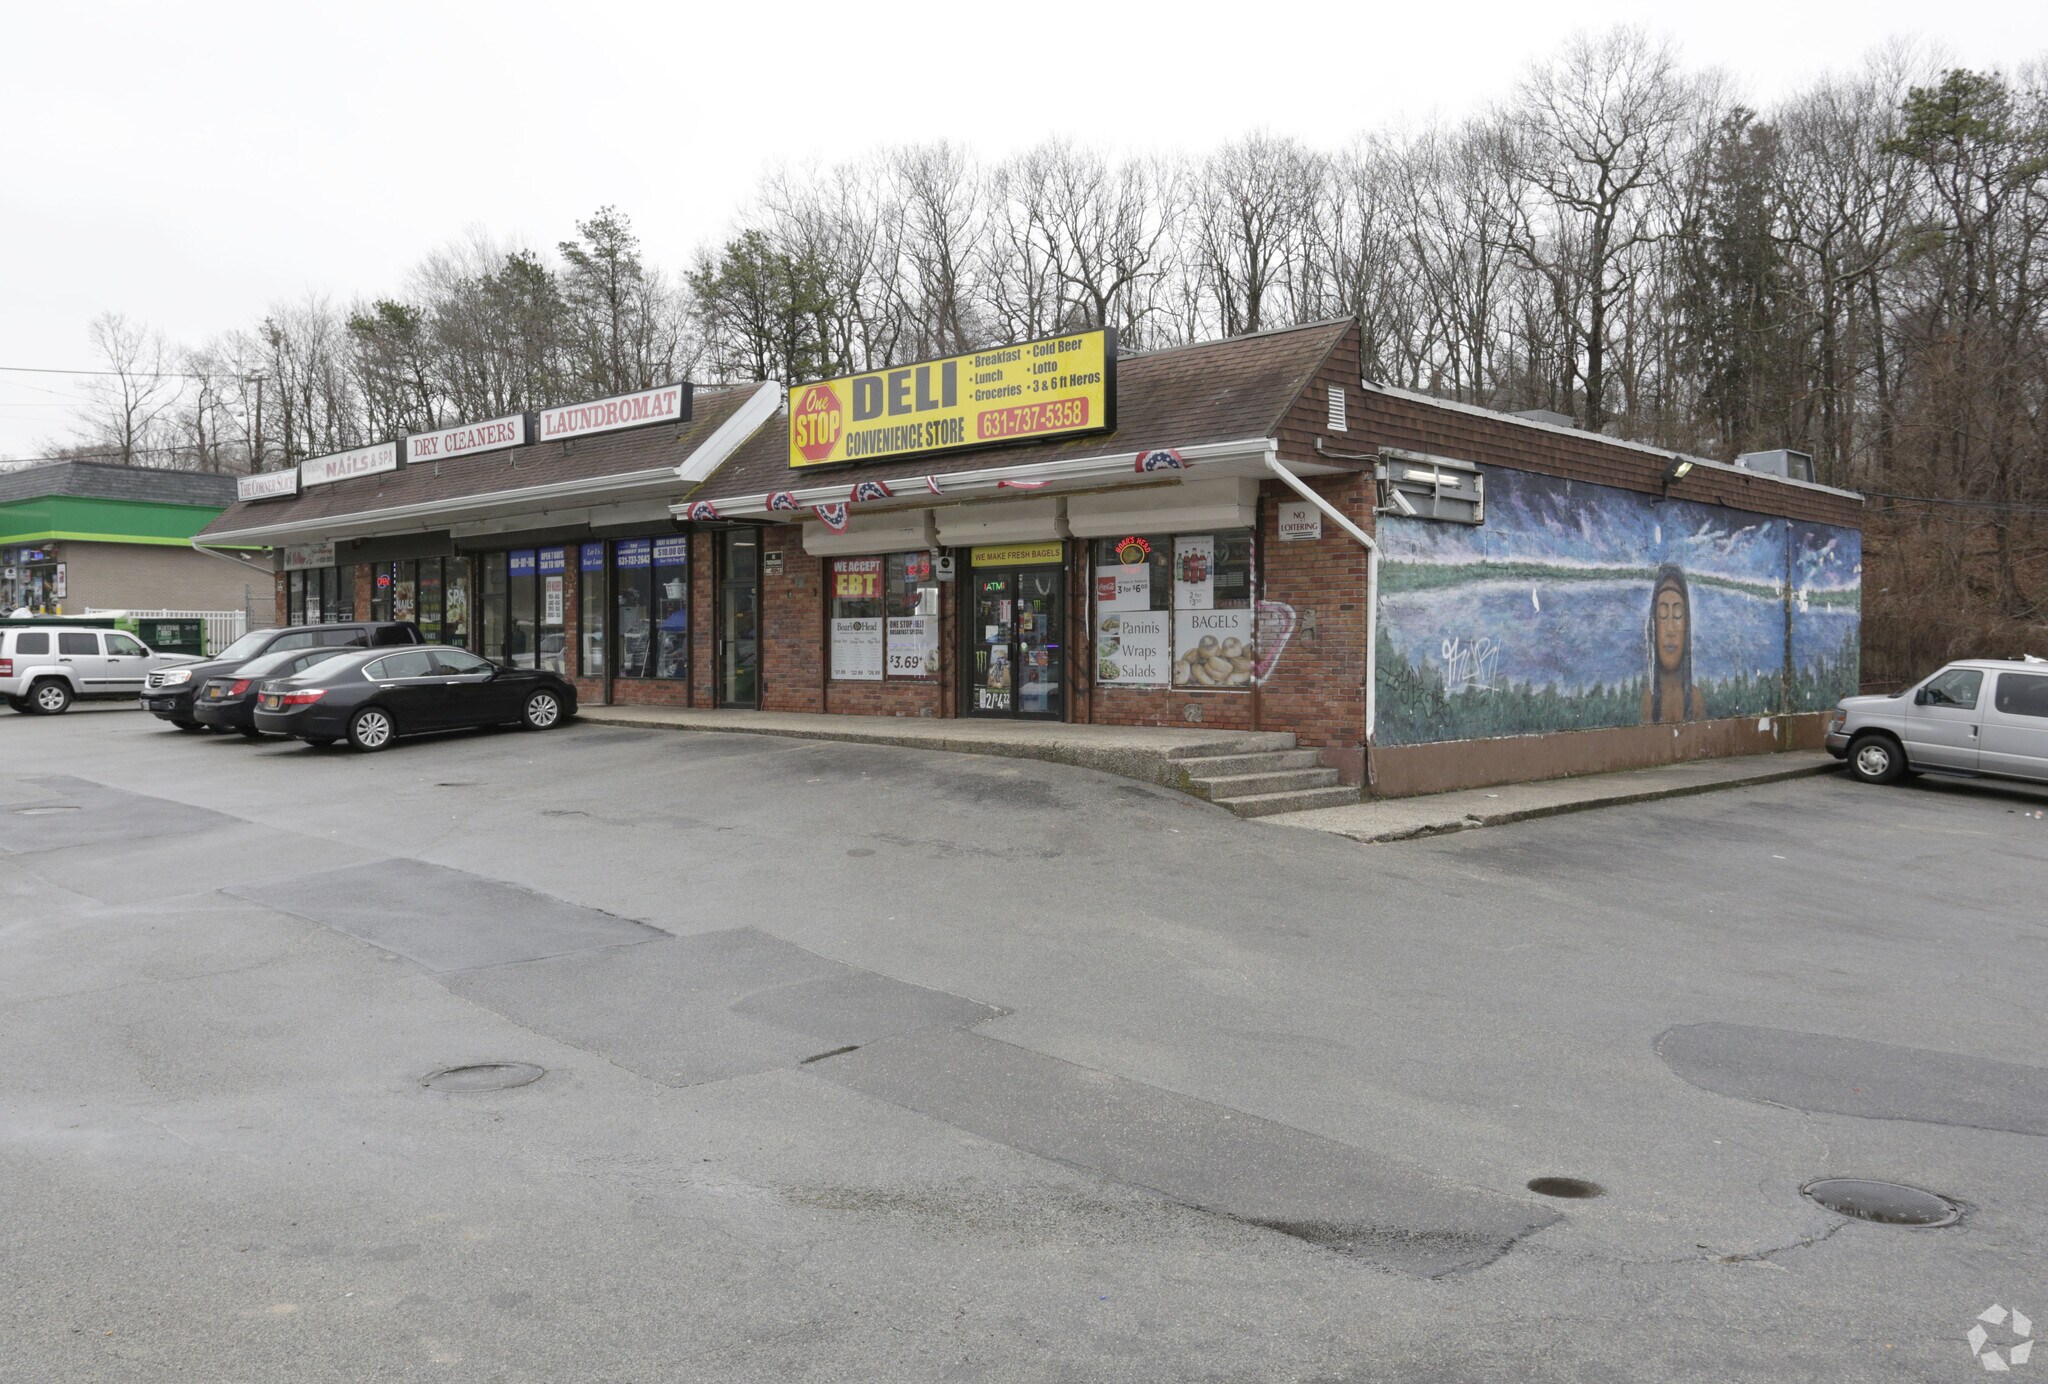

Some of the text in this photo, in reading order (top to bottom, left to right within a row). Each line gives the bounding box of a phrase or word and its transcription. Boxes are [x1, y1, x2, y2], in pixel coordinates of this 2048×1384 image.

[1033, 339, 1082, 357] Cold Beer
[975, 349, 1021, 368] Breakfast
[1033, 361, 1057, 375] Lotto
[975, 369, 1003, 384] Lunch
[1033, 372, 1100, 392] 3 & 6 ft Heros
[852, 361, 957, 422] DELI
[975, 384, 1022, 401] Groceries
[806, 389, 829, 412] One
[545, 391, 676, 436] LAUNDROMAT
[983, 400, 1081, 436] 631-737-5358
[796, 410, 840, 448] STOP
[846, 417, 964, 457] CONVENIENCE STORE
[413, 421, 515, 457] DRY CLEANERS
[370, 457, 376, 466] &
[378, 450, 393, 466] SPA
[239, 474, 295, 497] THE CORNER SLICE
[1293, 511, 1305, 519] NO
[1281, 522, 1318, 532] LOITERING
[1115, 536, 1151, 553] BOAR'S HEAD
[975, 549, 1060, 561] WE MAKE FRESH BAGELS
[834, 560, 880, 572] WE ACCEPT
[377, 577, 390, 586] OPEN
[836, 573, 877, 595] EBT
[986, 582, 1003, 591] ATM
[396, 599, 414, 609] NAILS
[447, 589, 464, 605] SPA
[837, 621, 877, 631] Boar's Head
[889, 620, 899, 628] ONE
[900, 620, 913, 628] STOP
[1122, 621, 1160, 634] Paninis
[1192, 615, 1239, 629] BAGELS
[1122, 645, 1157, 660] Wraps
[1122, 665, 1156, 677] Salads
